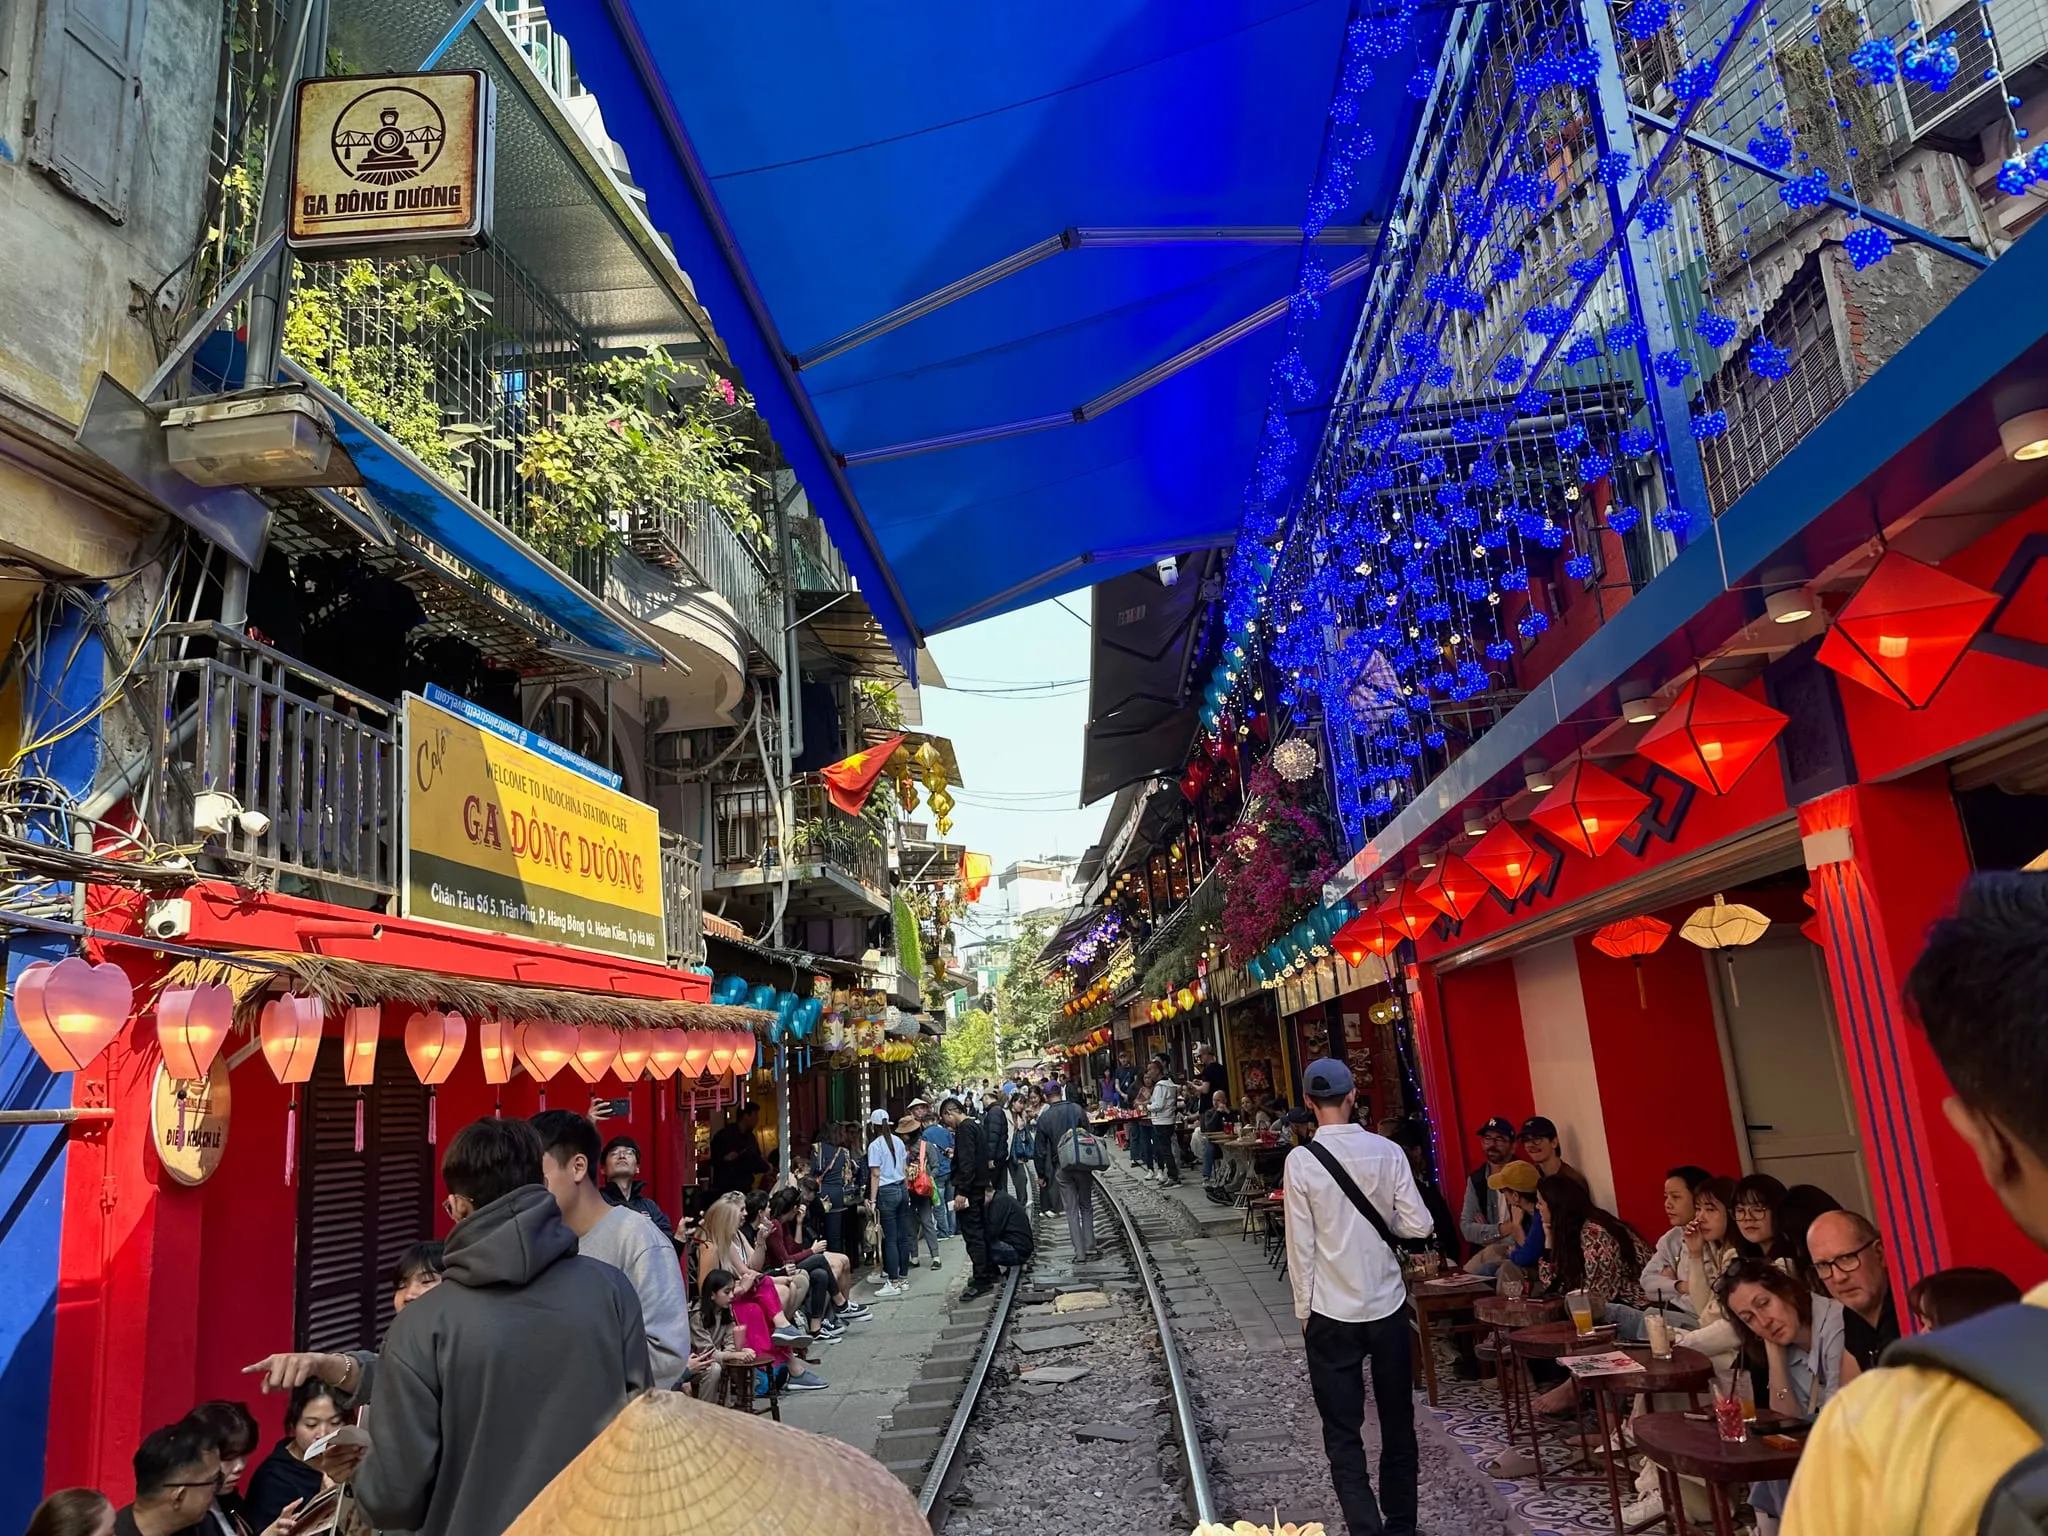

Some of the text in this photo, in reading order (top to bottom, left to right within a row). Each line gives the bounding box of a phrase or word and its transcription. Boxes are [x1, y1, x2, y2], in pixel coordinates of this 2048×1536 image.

[303, 184, 461, 216] GA ĐÔNG DƯƠNG
[485, 759, 628, 834] WELCOME TO INDOCHINA STATION CAFE
[463, 794, 644, 894] GA ĐÔNG DƯƠNG
[457, 890, 475, 910] Tàu
[476, 893, 489, 914] Số
[490, 898, 498, 918] 5,
[520, 903, 538, 925] Phú,
[539, 907, 547, 925] P.
[547, 910, 566, 934] Hàng
[586, 919, 595, 935] Q.
